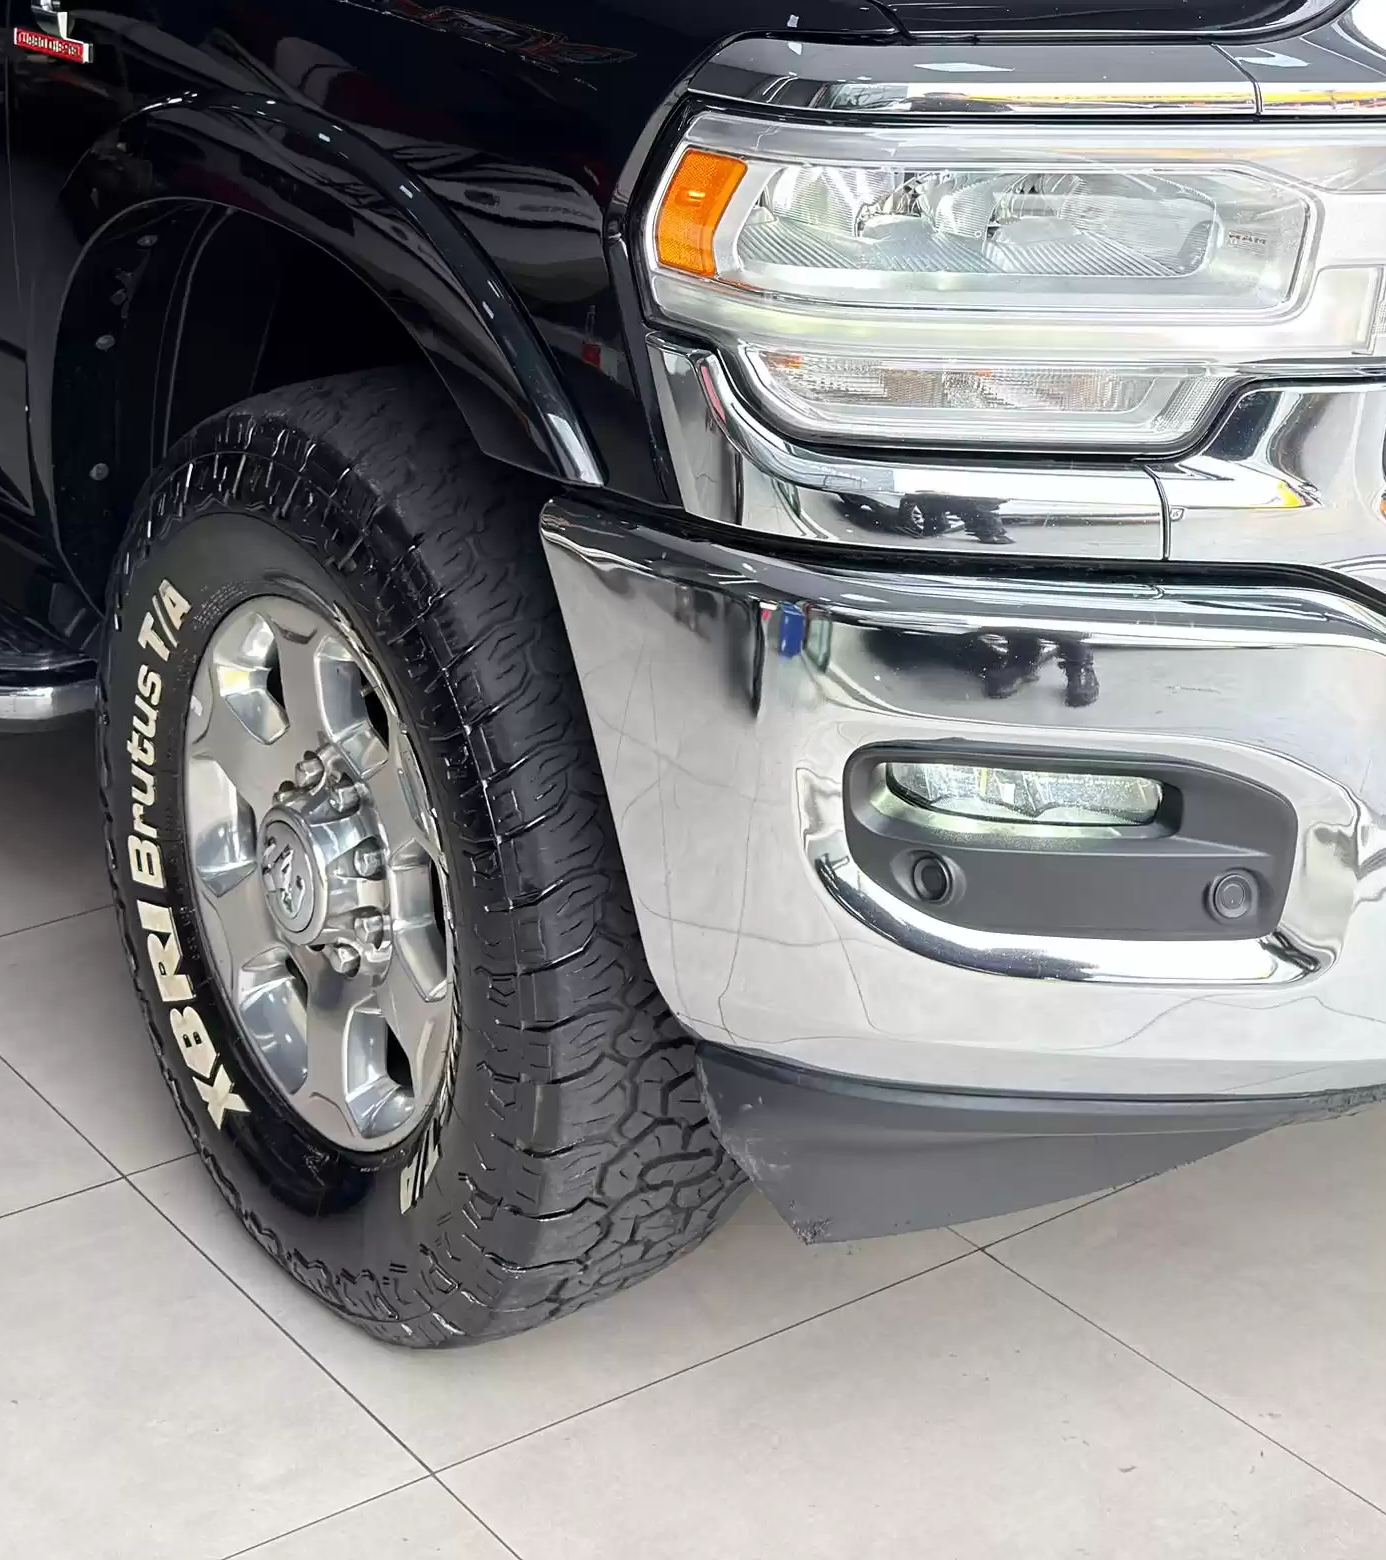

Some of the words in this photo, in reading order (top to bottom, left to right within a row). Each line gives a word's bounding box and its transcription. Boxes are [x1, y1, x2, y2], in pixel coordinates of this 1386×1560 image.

[138, 579, 193, 662] T/A
[127, 664, 166, 889] Brutus
[136, 899, 253, 1131] XBRI
